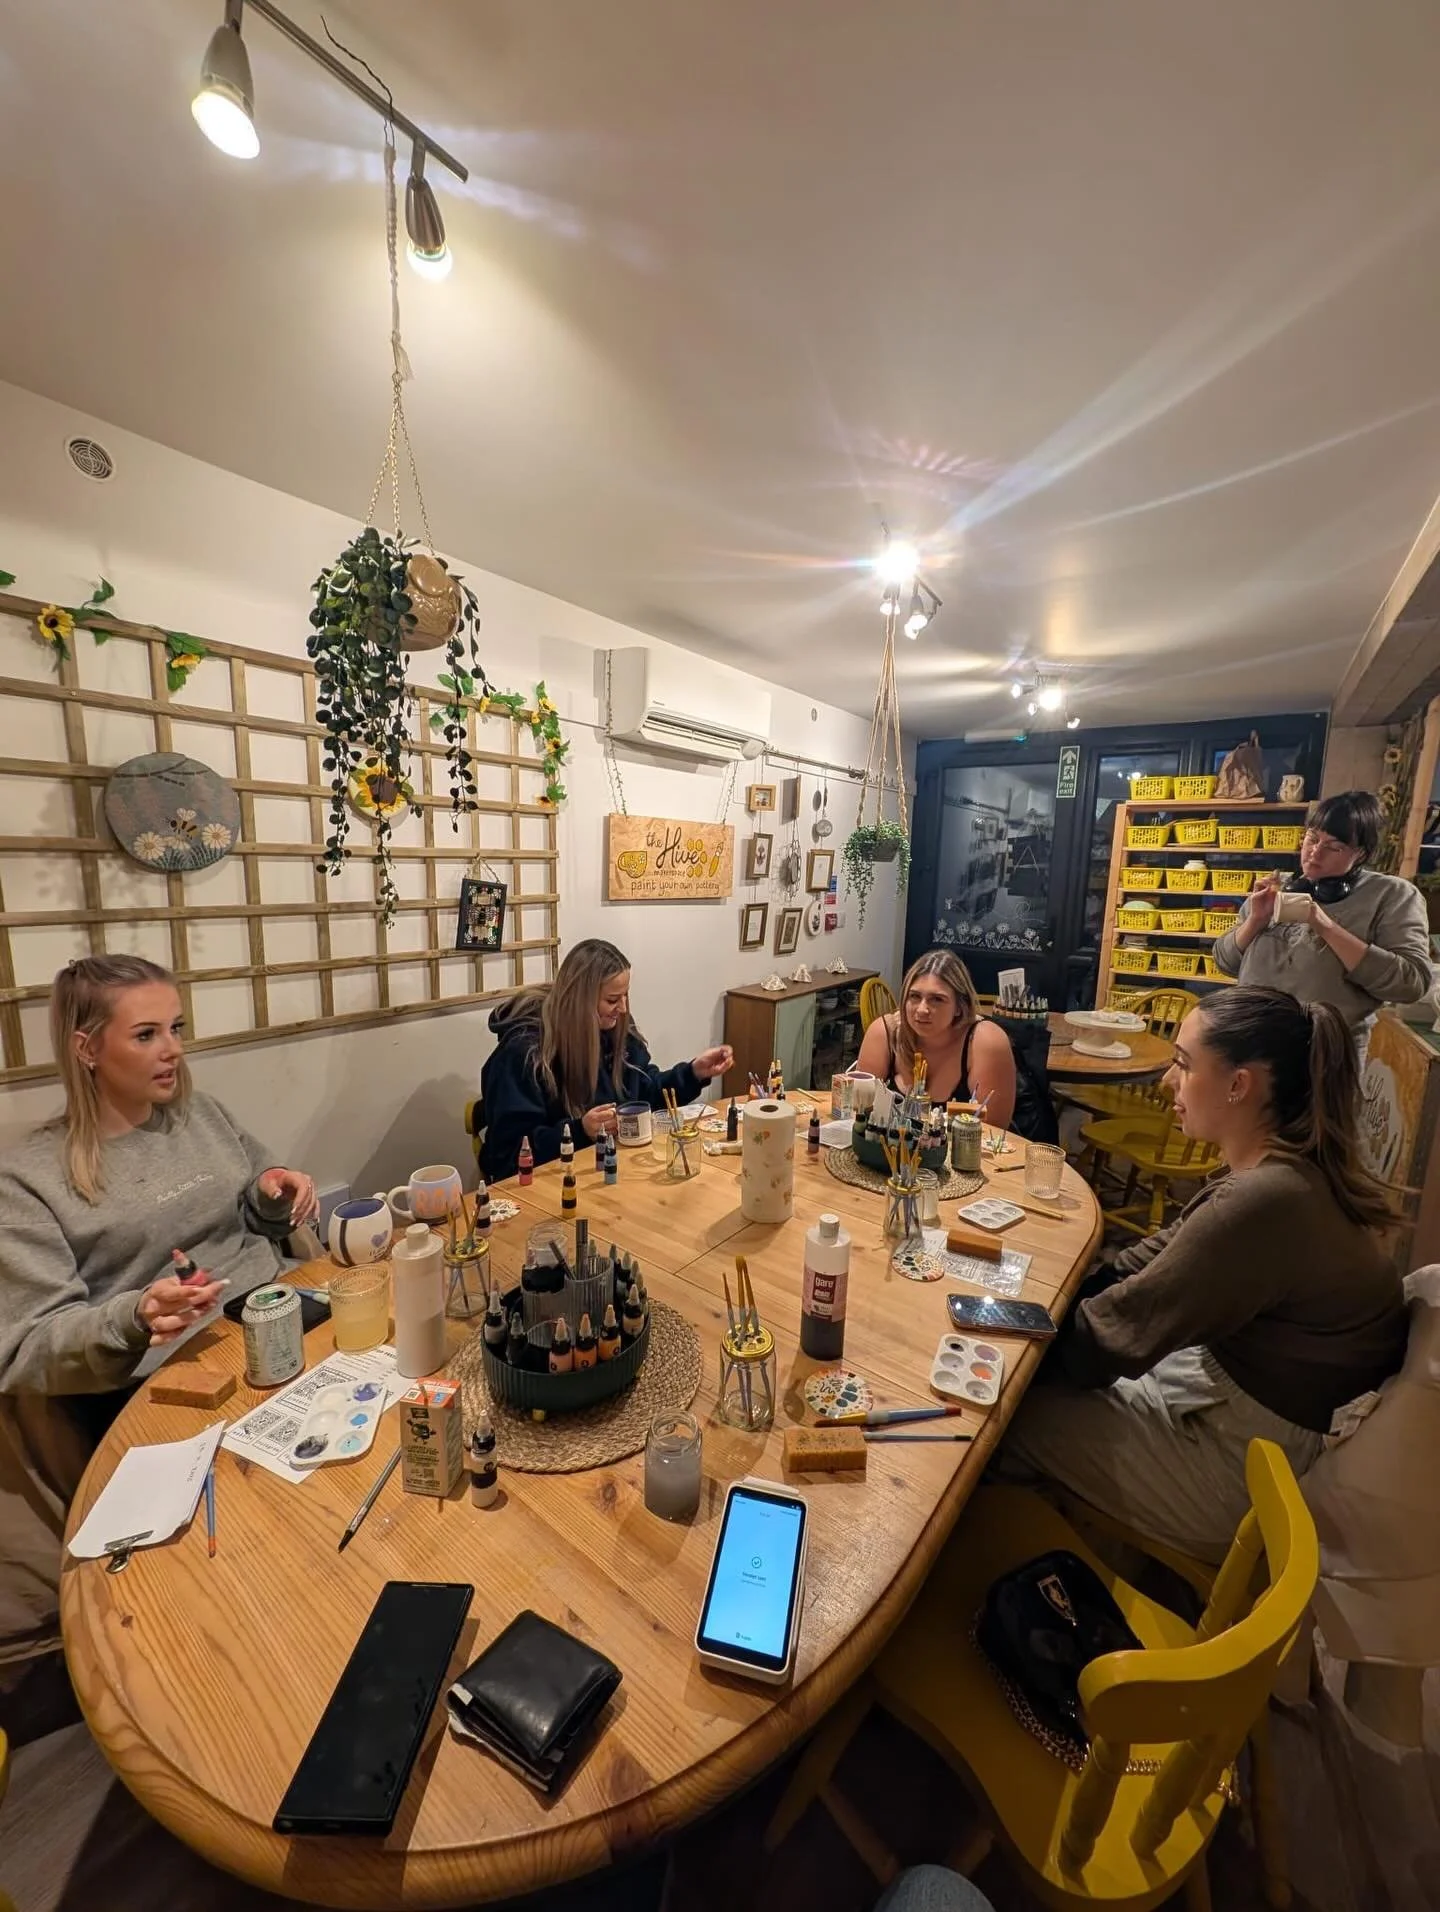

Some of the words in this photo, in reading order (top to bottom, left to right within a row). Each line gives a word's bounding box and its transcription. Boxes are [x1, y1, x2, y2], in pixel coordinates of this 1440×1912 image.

[646, 832, 663, 848] the
[656, 826, 700, 869] Hive
[631, 880, 656, 896] paint
[660, 881, 678, 896] your
[695, 881, 720, 895] pottery
